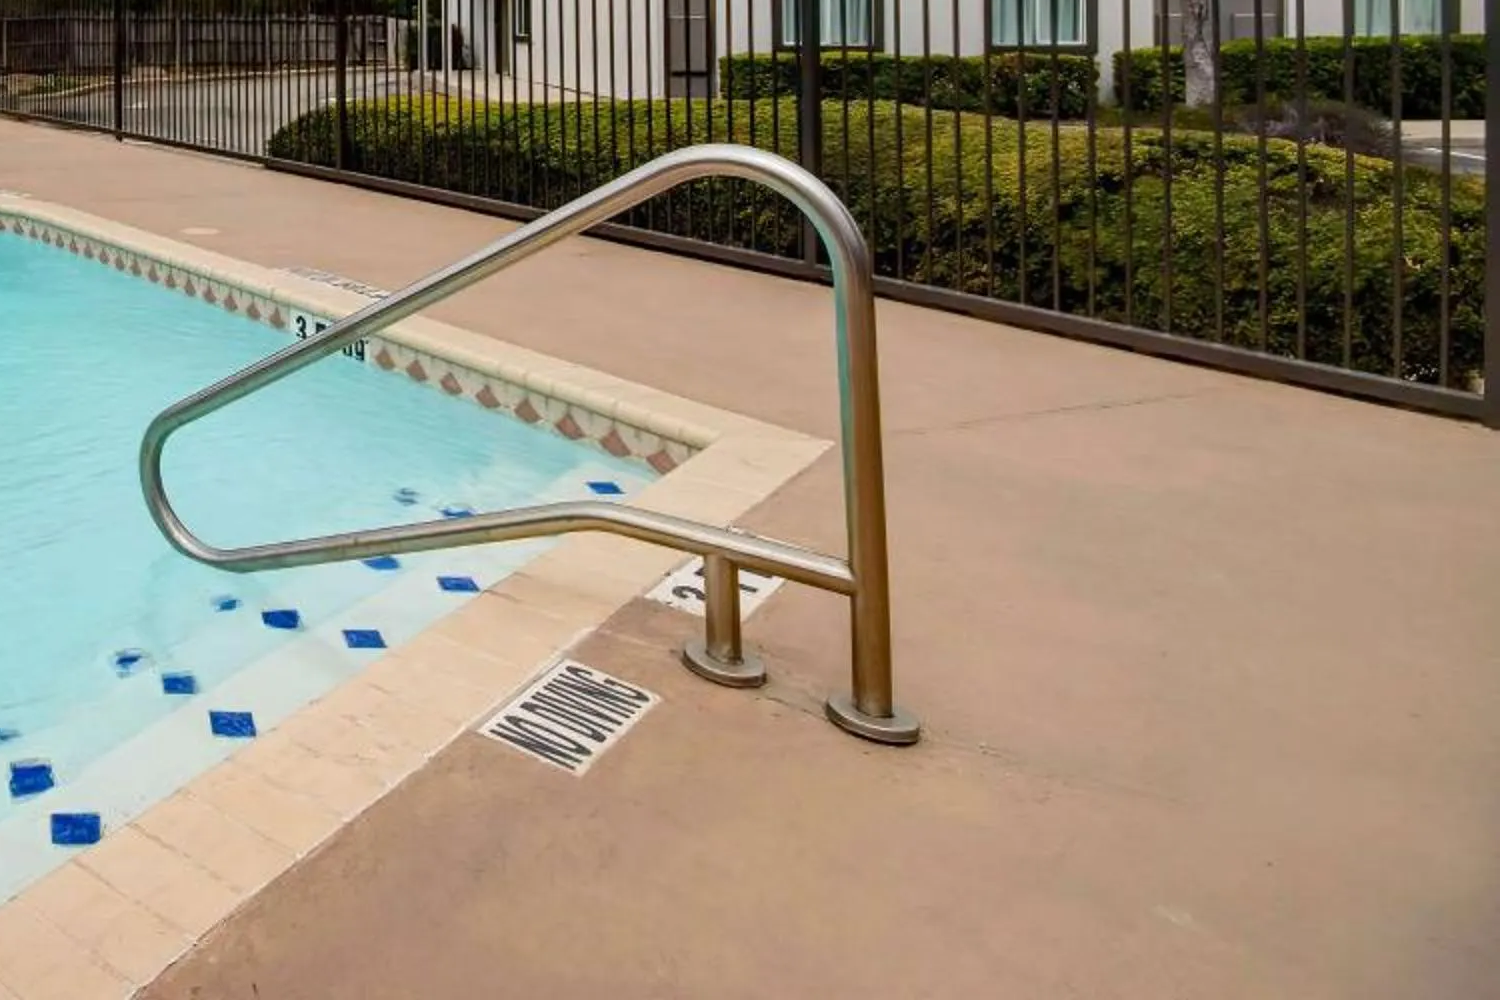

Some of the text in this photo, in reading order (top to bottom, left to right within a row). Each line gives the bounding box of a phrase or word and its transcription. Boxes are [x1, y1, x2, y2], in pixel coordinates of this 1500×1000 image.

[295, 314, 307, 341] 3
[488, 664, 651, 771] NO DIVING
